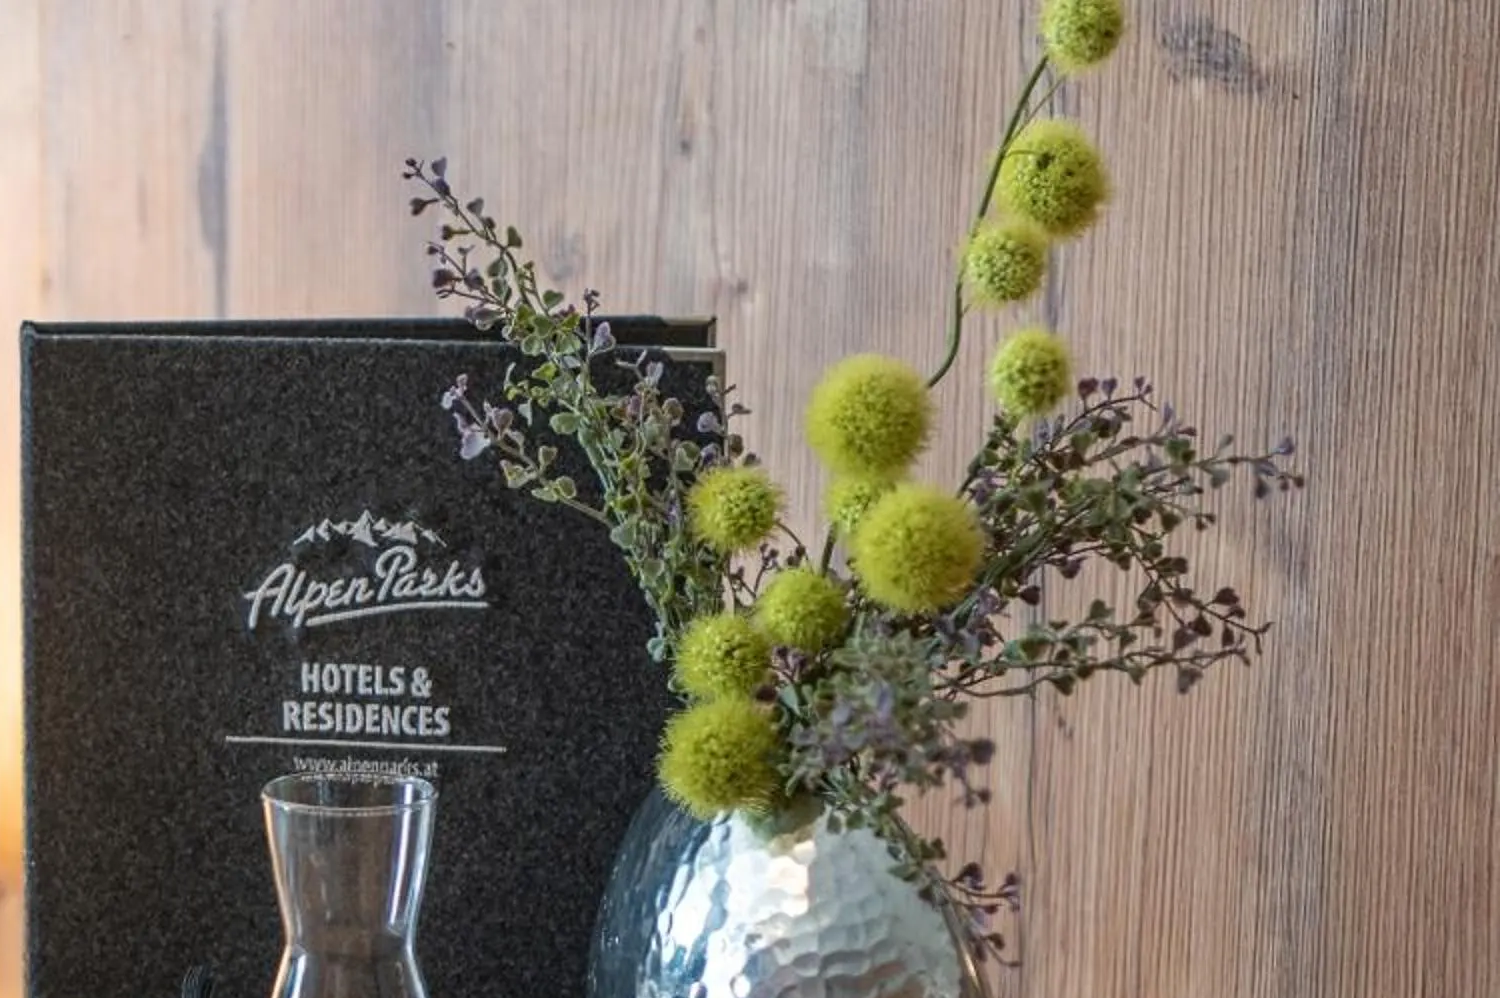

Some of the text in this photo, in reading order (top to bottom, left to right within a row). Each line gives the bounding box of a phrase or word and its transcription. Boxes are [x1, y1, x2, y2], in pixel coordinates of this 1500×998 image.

[244, 545, 487, 630] Alpen Parks
[301, 662, 433, 698] HOTELS &
[282, 701, 451, 737] RESIDENCES
